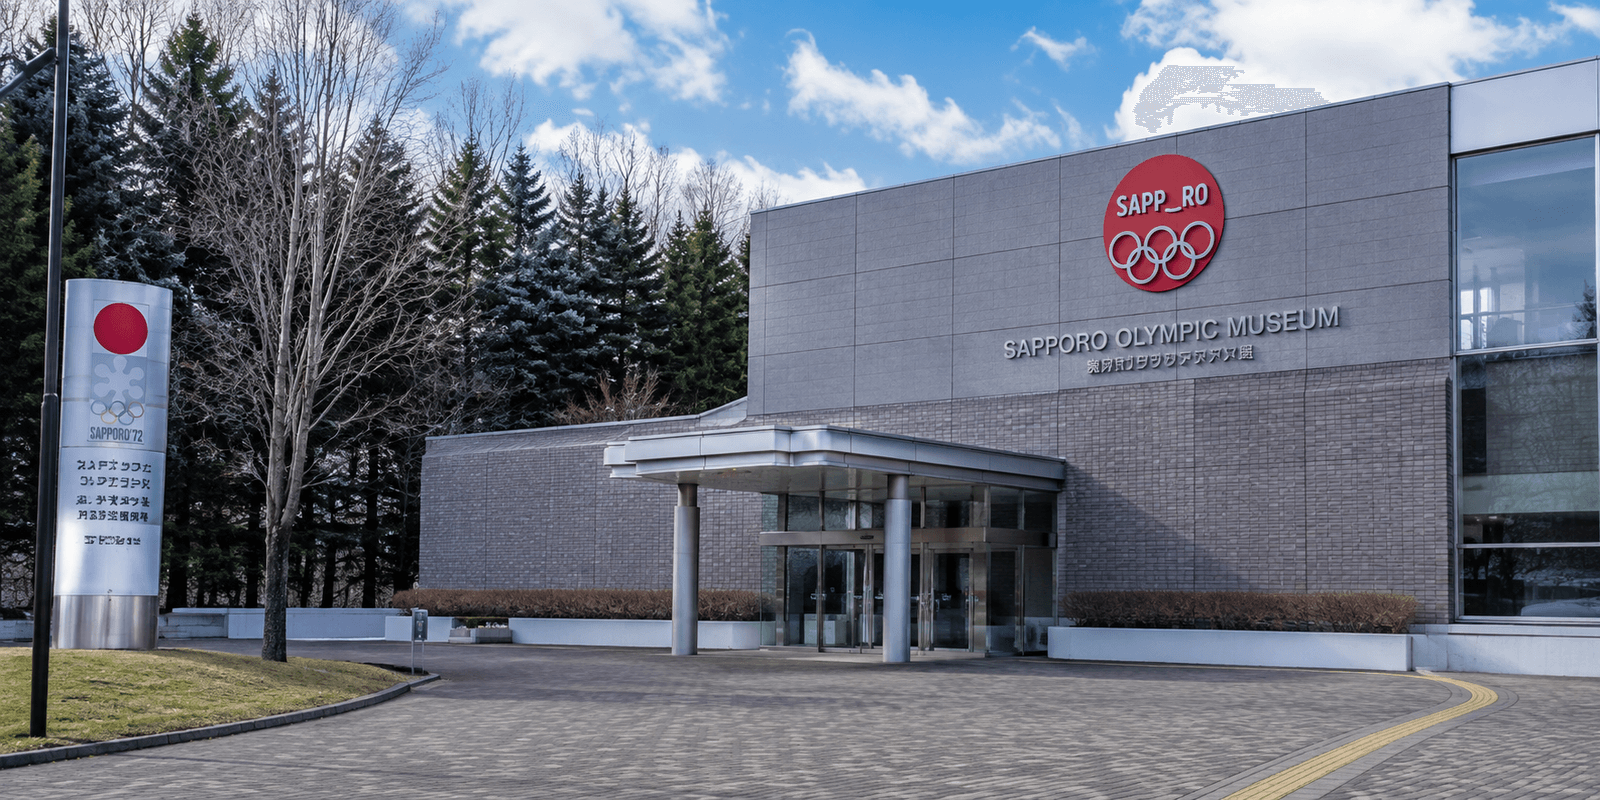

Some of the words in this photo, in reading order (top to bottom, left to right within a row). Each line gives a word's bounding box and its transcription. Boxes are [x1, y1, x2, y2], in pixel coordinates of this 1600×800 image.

[1003, 330, 1108, 359] SAPPORO
[1115, 318, 1219, 348] OLYMPIC
[1226, 306, 1340, 338] MUSEUM
